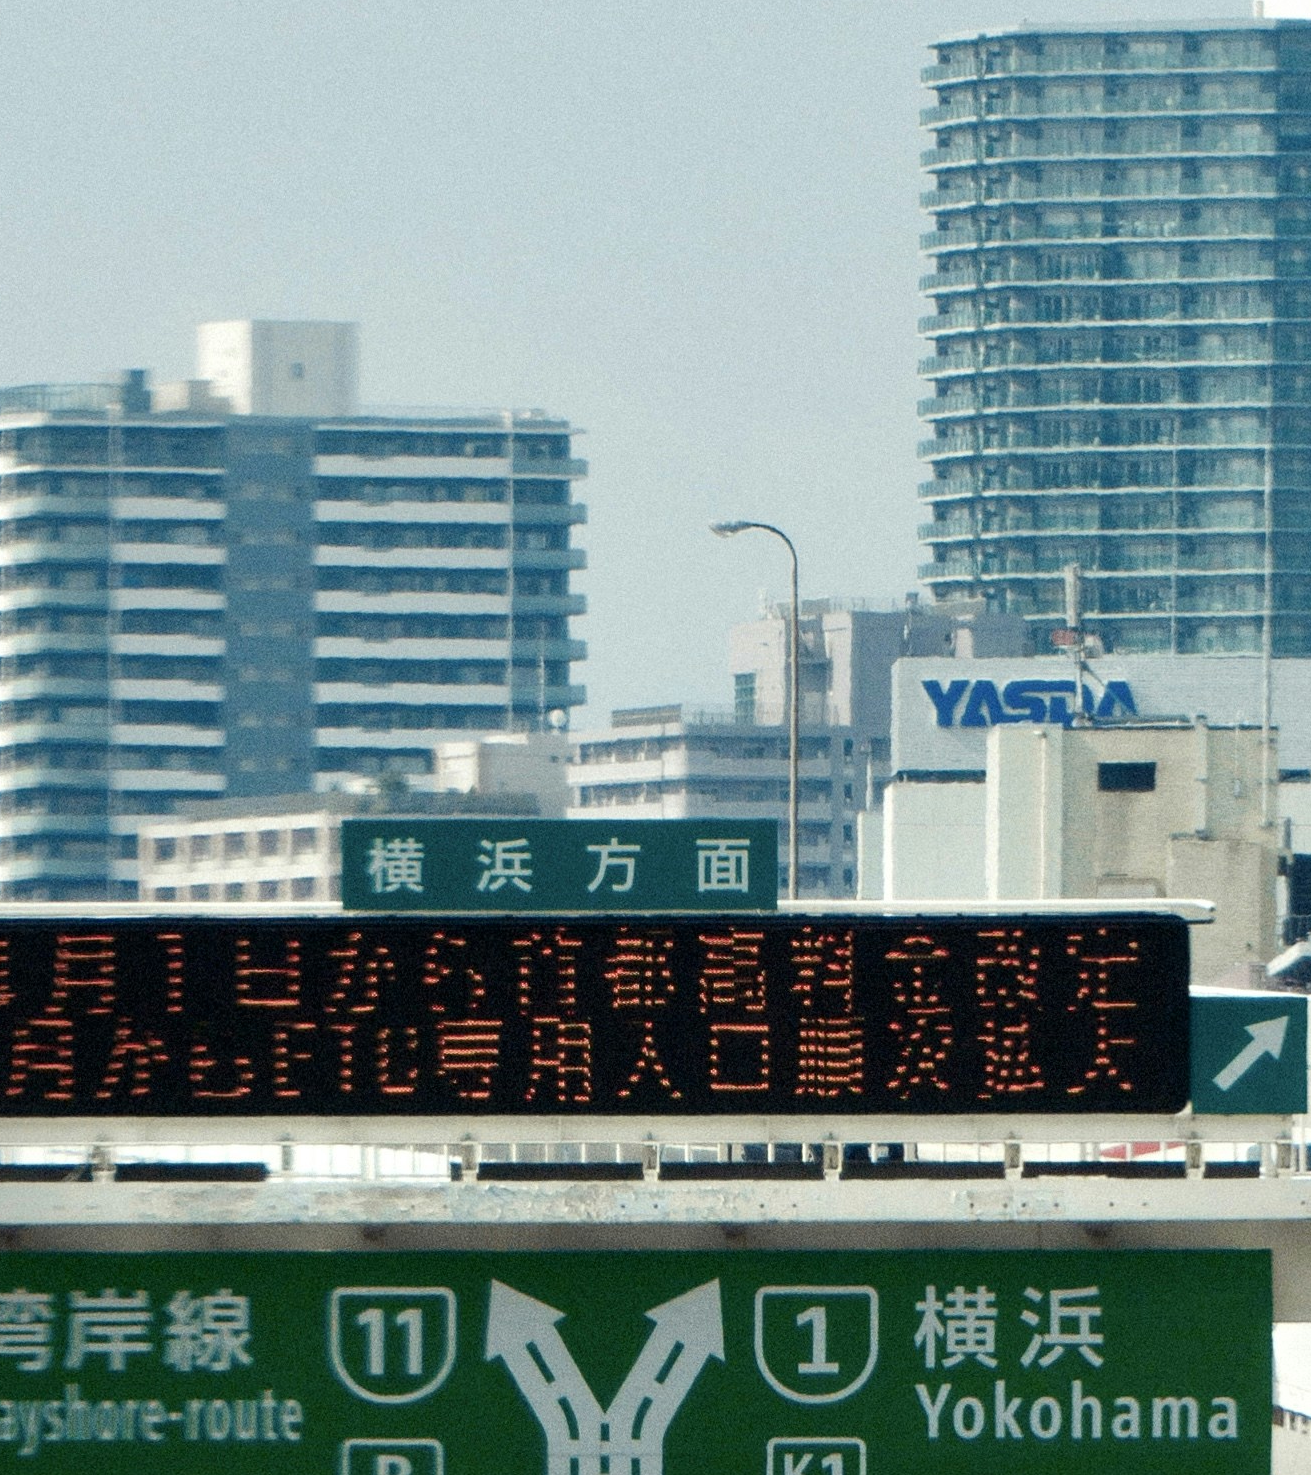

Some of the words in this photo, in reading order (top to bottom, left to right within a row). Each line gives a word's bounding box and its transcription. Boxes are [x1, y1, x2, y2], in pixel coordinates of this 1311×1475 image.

[367, 838, 751, 893] 横浜方面
[354, 1308, 429, 1376] 11
[795, 1307, 841, 1372] 1
[912, 1285, 1107, 1371] 横浜
[915, 1381, 1239, 1441] Yokohama
